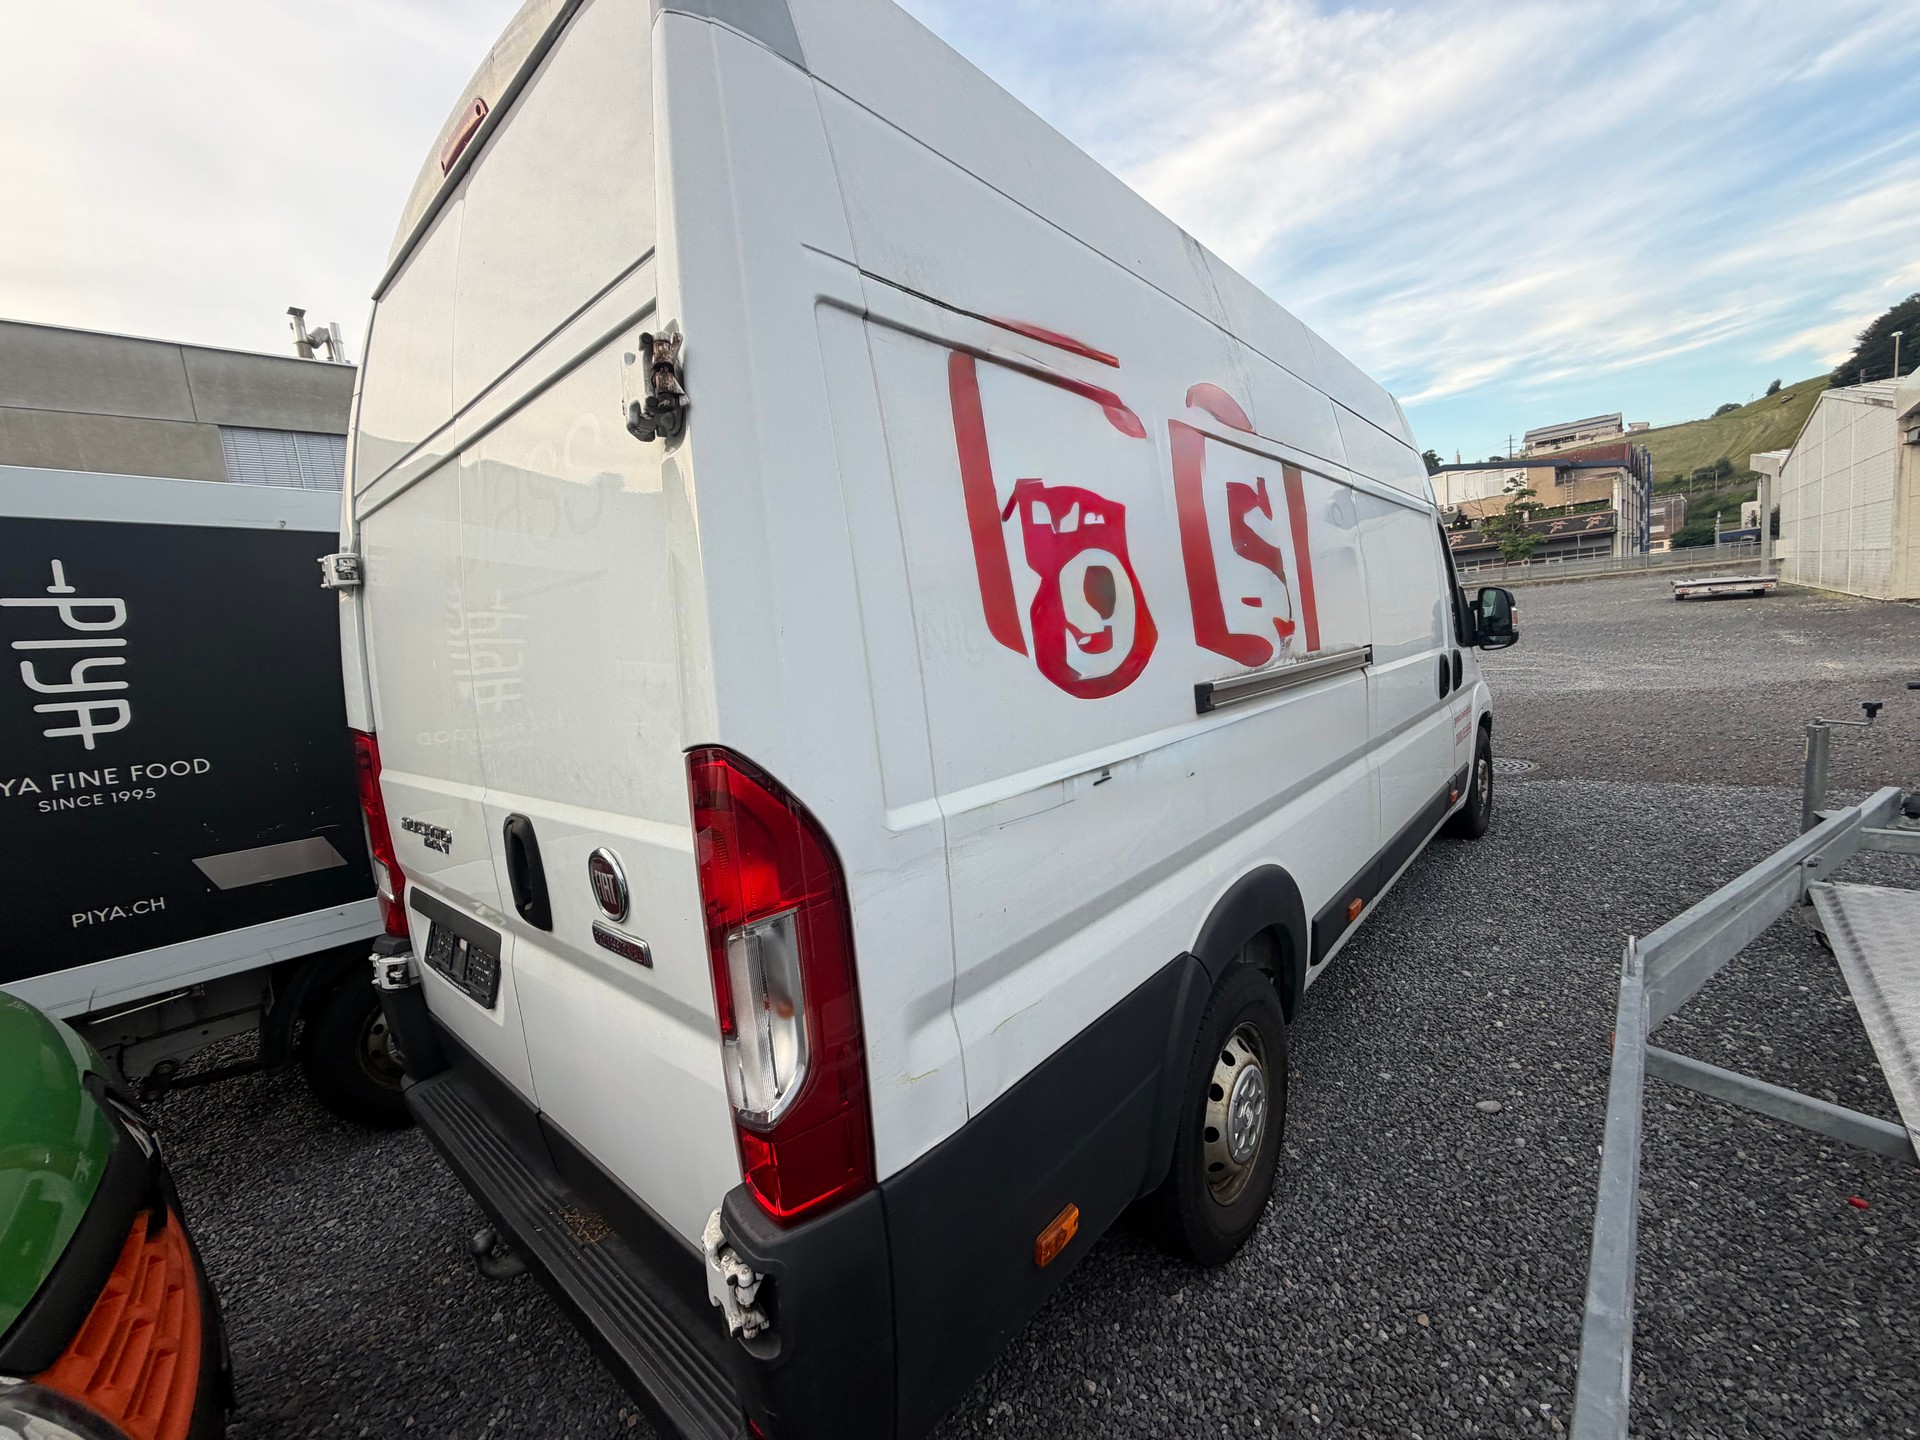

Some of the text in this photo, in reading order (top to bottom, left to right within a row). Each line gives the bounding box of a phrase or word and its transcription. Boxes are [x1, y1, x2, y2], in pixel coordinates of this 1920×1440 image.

[51, 767, 119, 792] FINE
[130, 758, 210, 782] FOOD
[38, 787, 156, 813] SINCE 1995
[594, 869, 617, 905] FIAT
[71, 896, 166, 928] PIYA.CH
